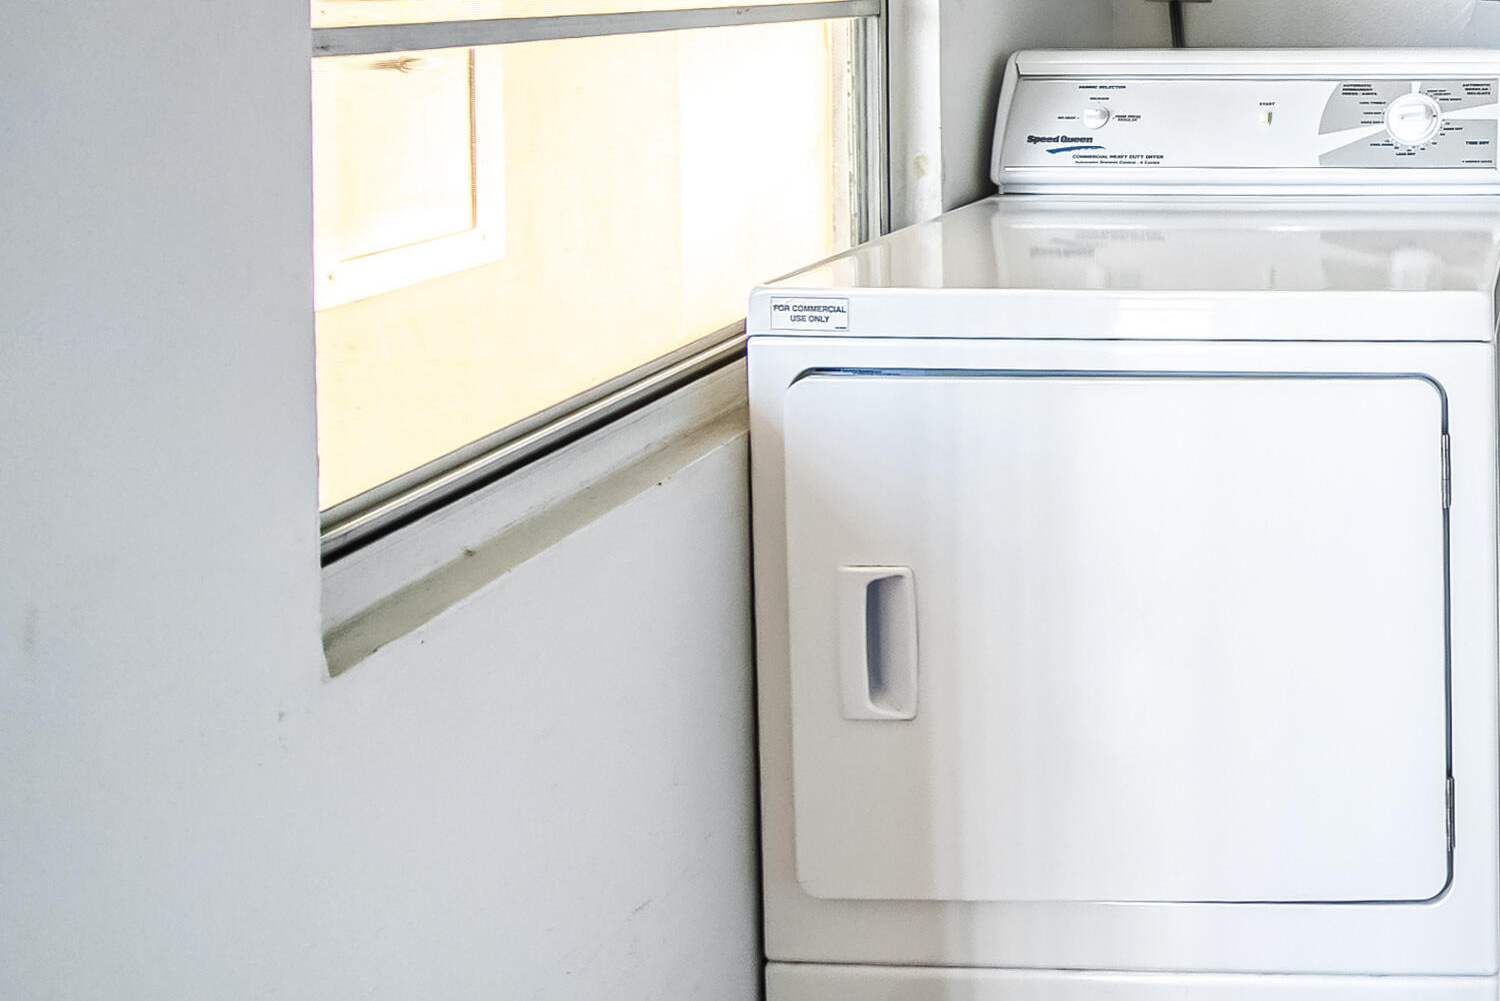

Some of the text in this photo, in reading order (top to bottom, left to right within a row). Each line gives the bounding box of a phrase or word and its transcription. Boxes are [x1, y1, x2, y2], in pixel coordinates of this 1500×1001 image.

[1026, 135, 1094, 145] Speed Queen
[773, 304, 847, 314] FOR COMMERCIAL
[789, 314, 830, 323] USE ONLY
